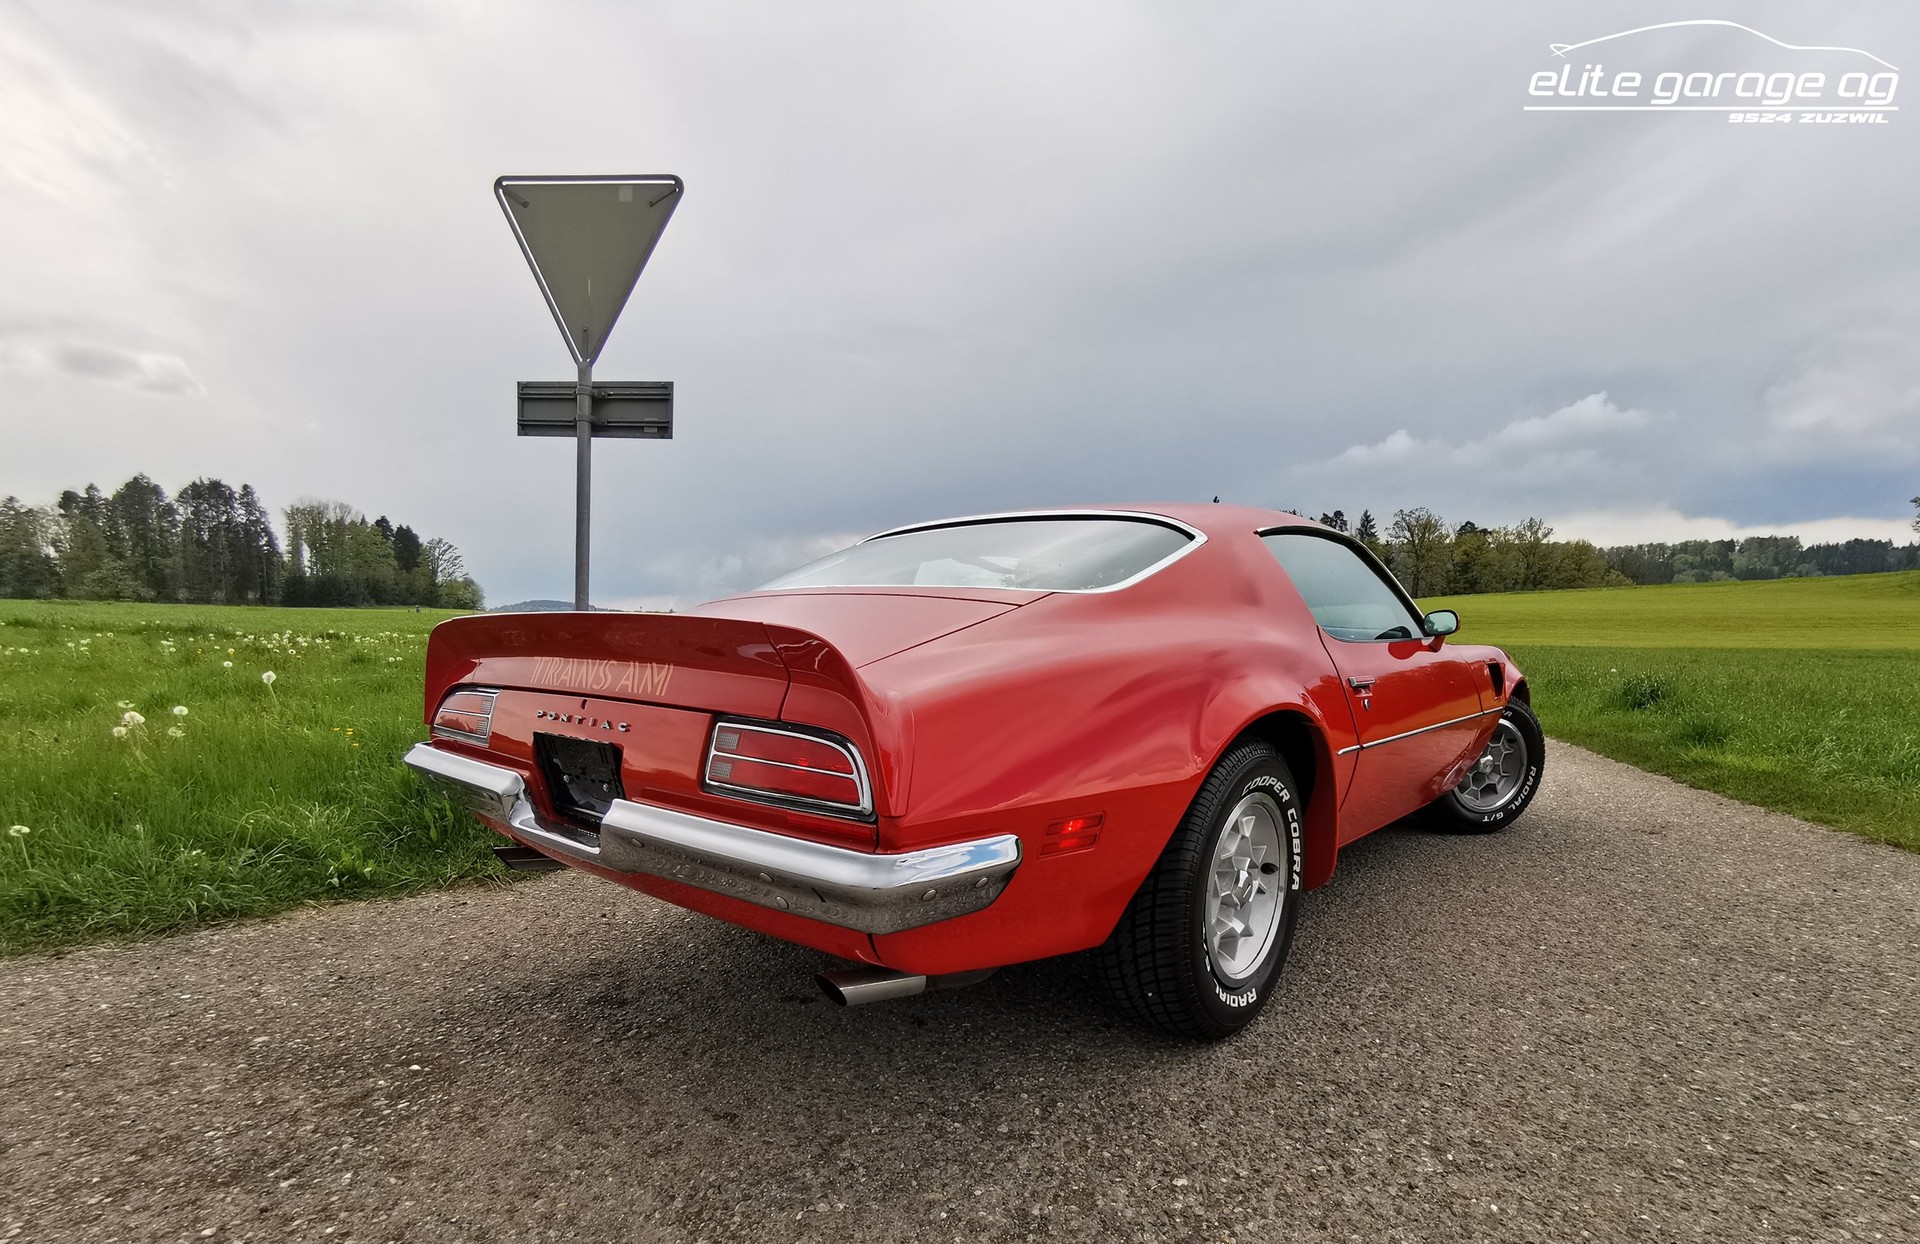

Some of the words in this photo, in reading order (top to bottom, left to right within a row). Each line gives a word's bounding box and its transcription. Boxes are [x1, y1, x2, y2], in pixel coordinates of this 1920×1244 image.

[530, 656, 618, 691] TRANS
[615, 660, 674, 696] AM
[536, 710, 630, 732] PONTIAC
[1508, 765, 1537, 810] RADIAL
[1241, 775, 1291, 802] COOPER
[1287, 808, 1301, 890] COBRA
[1482, 811, 1504, 822] G/T
